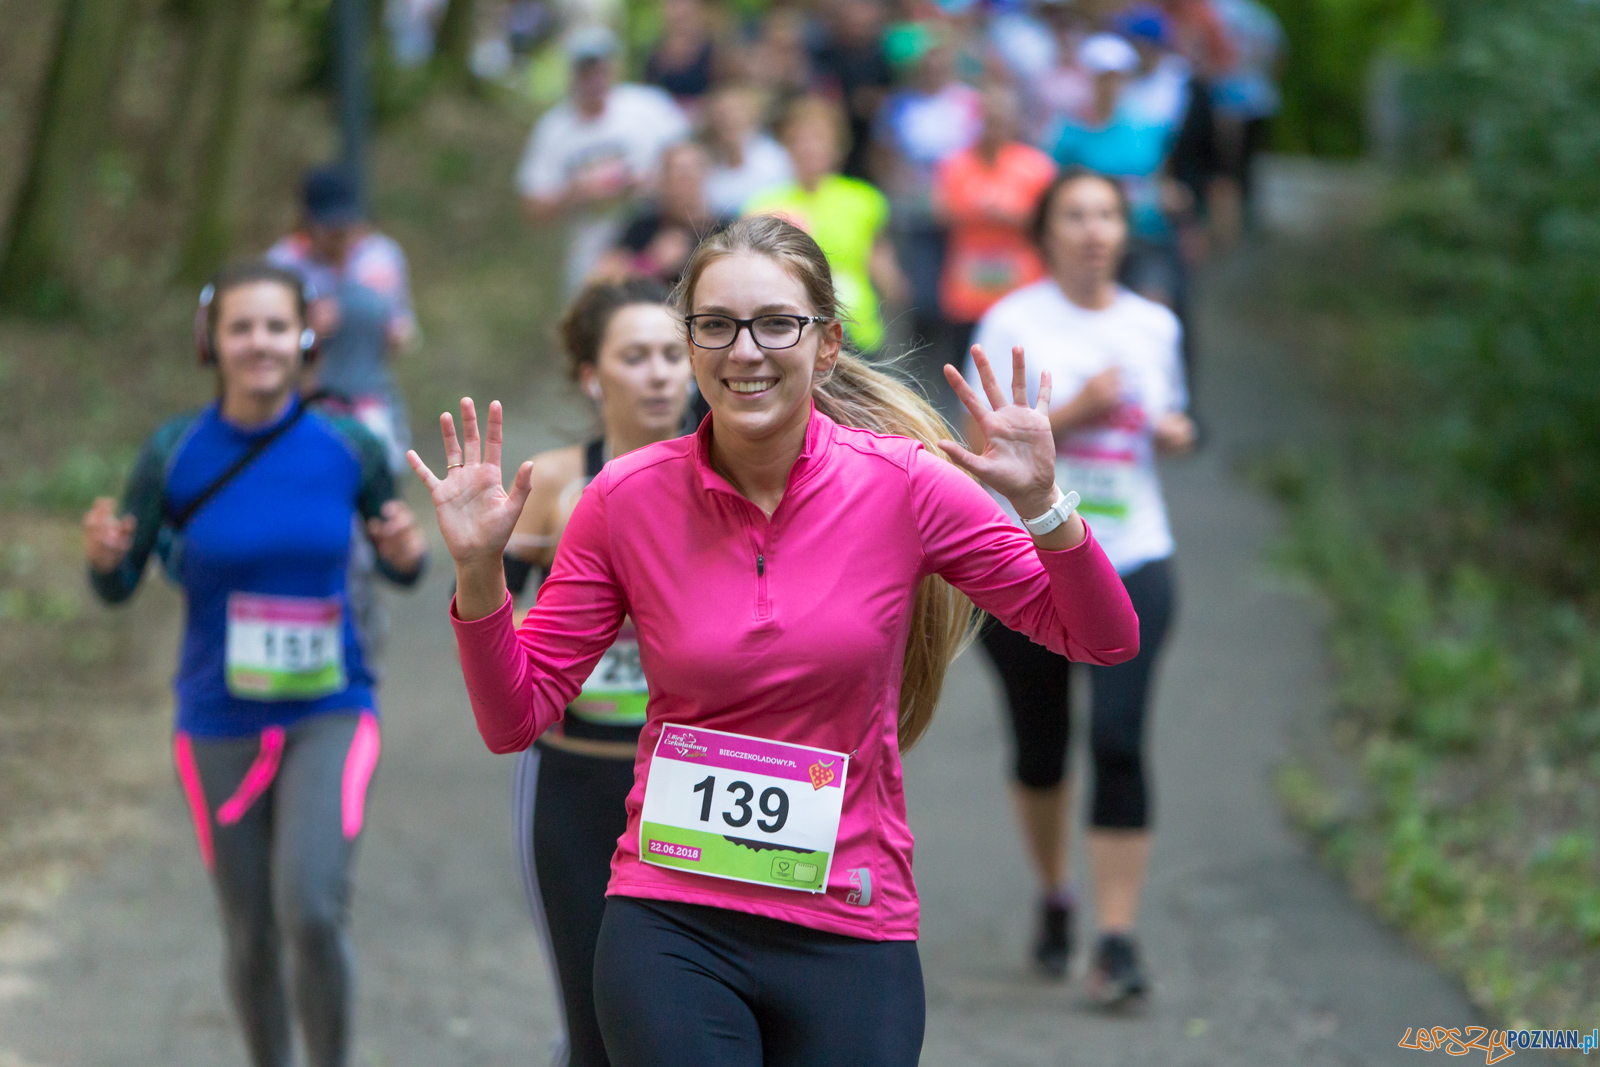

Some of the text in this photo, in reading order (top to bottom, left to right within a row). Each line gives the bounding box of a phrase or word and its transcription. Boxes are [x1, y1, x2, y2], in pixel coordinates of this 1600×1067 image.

[664, 738, 708, 753] Czekoladowy
[719, 748, 797, 768] BIEGCZEKOLADOWY.PL
[693, 775, 790, 834] 139
[650, 842, 699, 859] 22.06.2018
[845, 868, 862, 905] RUN
